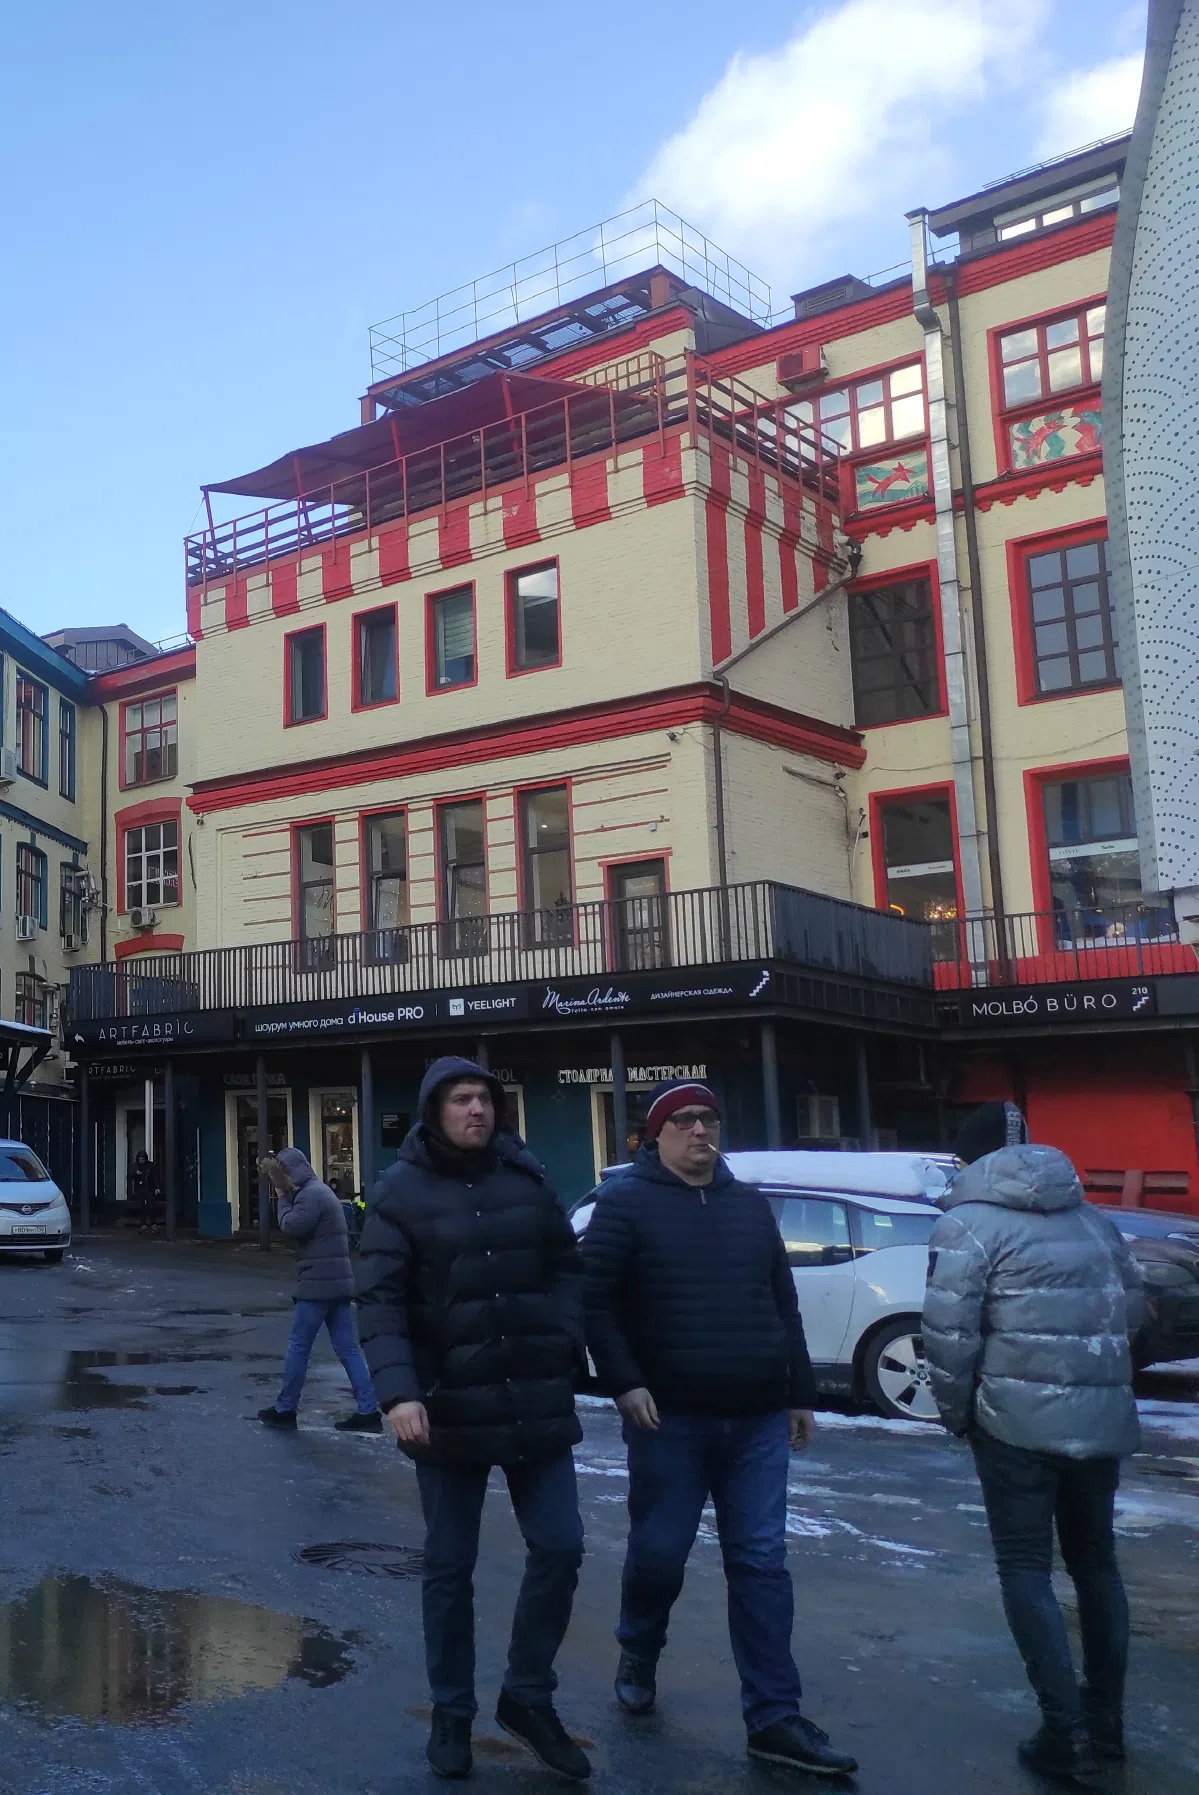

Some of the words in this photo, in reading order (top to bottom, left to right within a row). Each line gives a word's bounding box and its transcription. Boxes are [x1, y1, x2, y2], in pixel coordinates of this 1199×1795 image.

[650, 988, 702, 1000] ДИЗАЙНЕРСКАЯ
[702, 986, 733, 997] ОДЕЖДА
[1131, 986, 1148, 995] 210
[467, 997, 517, 1011] YEELIGHT
[972, 995, 1039, 1017] MOLBÓ
[1046, 993, 1117, 1012] BÜRO
[397, 1006, 424, 1020] PRO
[255, 1022, 287, 1034] шоурум
[288, 1019, 318, 1032] умного
[319, 1016, 344, 1029] дома
[87, 1064, 136, 1076] RTFABRIC
[557, 1067, 615, 1084] СТОЛЯРНА
[626, 1064, 708, 1082] МАСТЕРСКАЯ
